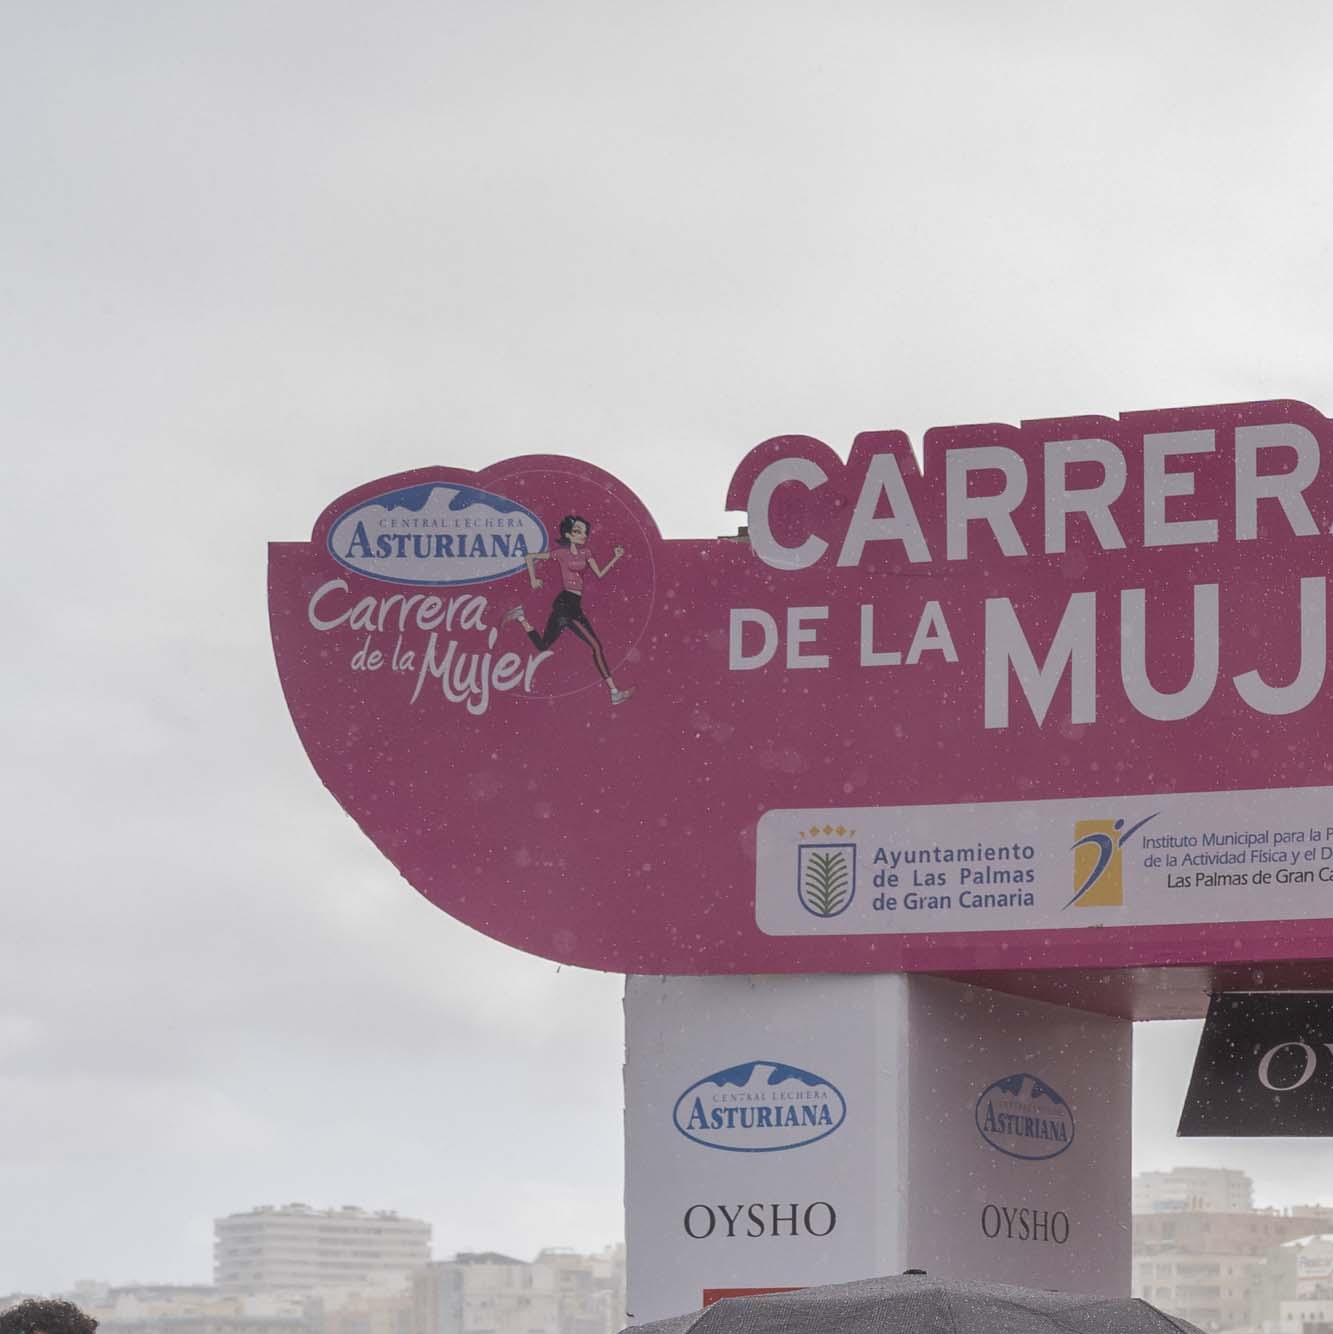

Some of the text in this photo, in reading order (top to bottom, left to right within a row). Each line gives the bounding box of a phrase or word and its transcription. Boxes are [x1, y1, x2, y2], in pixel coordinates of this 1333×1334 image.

[379, 514, 524, 530] CENTRAL LECHERA
[345, 520, 529, 562] ASTURIANA
[308, 578, 489, 635] Carrera
[728, 605, 829, 670] DE
[860, 601, 959, 667] LA
[351, 629, 554, 714] de la Mujer
[1142, 830, 1197, 850] Instituto
[1201, 827, 1269, 849] Municipal
[1273, 831, 1304, 848] para
[1308, 827, 1322, 843] la
[873, 843, 1035, 868] Ayuntamiento
[1144, 852, 1162, 869] de
[1165, 851, 1178, 867] la
[1182, 848, 1246, 867] Actividad
[1251, 846, 1287, 865] Física
[1291, 851, 1301, 865] y
[1304, 846, 1316, 862] el
[873, 863, 1035, 889] de Las Palmas
[1167, 870, 1191, 889] Las
[1194, 867, 1249, 888] Palmas
[1252, 866, 1271, 885] de
[1275, 866, 1314, 885] Gran
[873, 888, 1035, 911] de Gran Canaria
[713, 1089, 828, 1102] CENTRAL LECHERA
[687, 1096, 833, 1131] ASTURIANA
[984, 1104, 1068, 1142] ASTURIANA
[683, 1201, 837, 1239] OYSHO
[981, 1204, 1069, 1244] OYSHO
